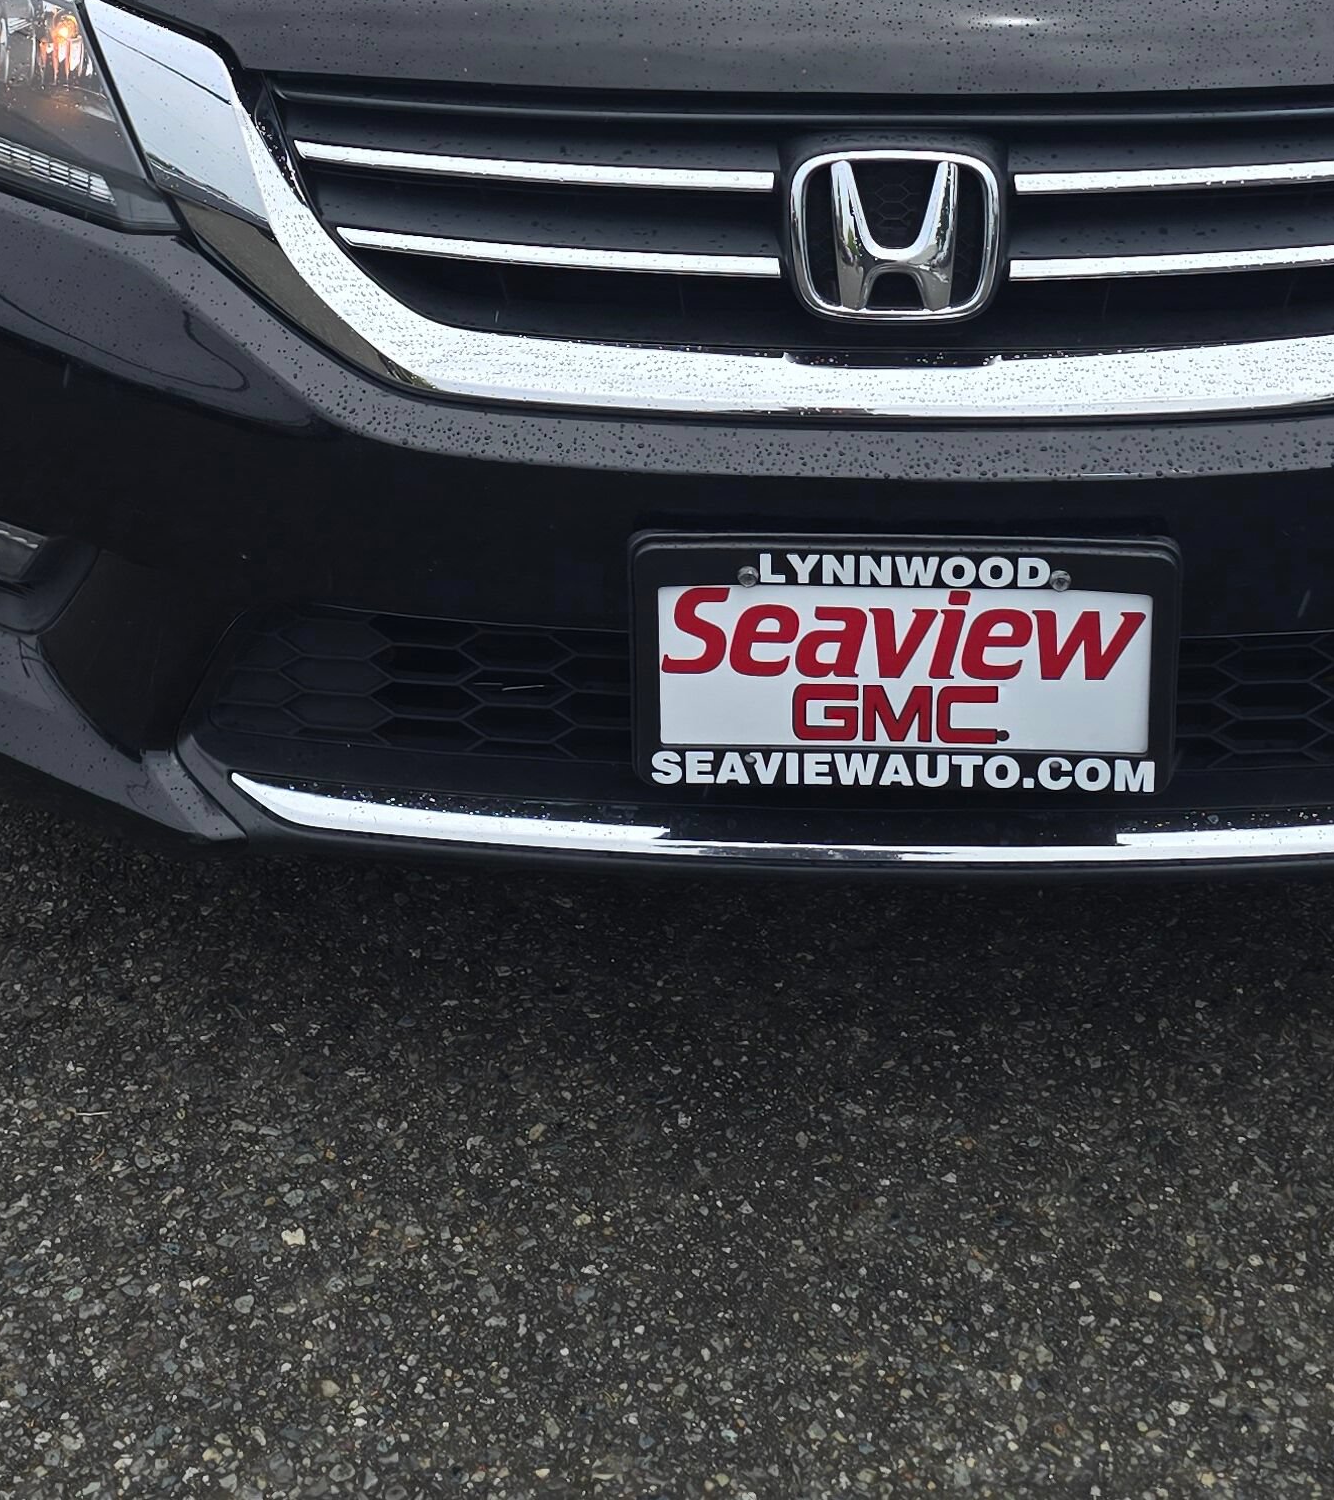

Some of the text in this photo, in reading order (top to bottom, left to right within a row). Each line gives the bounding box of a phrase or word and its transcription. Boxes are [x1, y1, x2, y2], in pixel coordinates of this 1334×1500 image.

[759, 553, 1051, 587] LYNNWOOD
[661, 587, 1147, 681] Seaview
[651, 751, 1156, 793] SEAVIEWAUTO.COM
